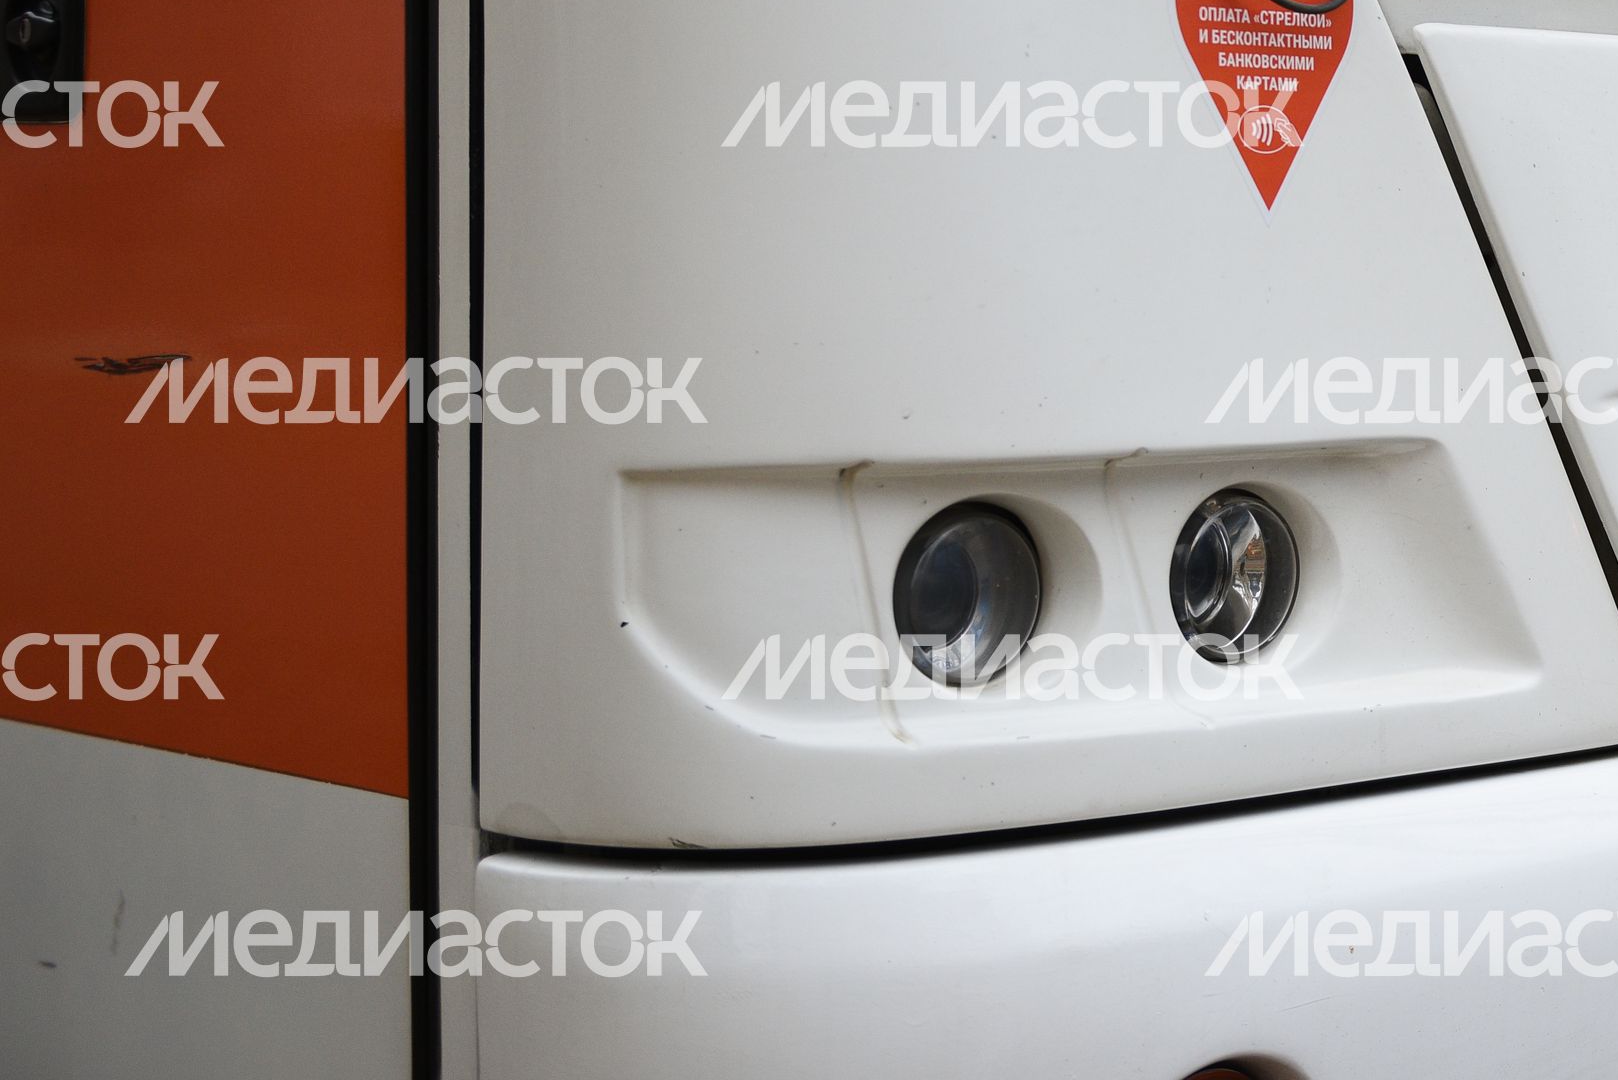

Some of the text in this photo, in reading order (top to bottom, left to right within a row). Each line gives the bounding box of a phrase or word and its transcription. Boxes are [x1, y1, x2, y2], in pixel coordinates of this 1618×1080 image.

[1199, 6, 1250, 24] ОПЛАТА
[1199, 28, 1332, 50] И БЕСКОНТАКТНЫМИ
[1218, 52, 1315, 71] БАНКОВСКИМИ
[1236, 75, 1298, 92] КАРТАМИ
